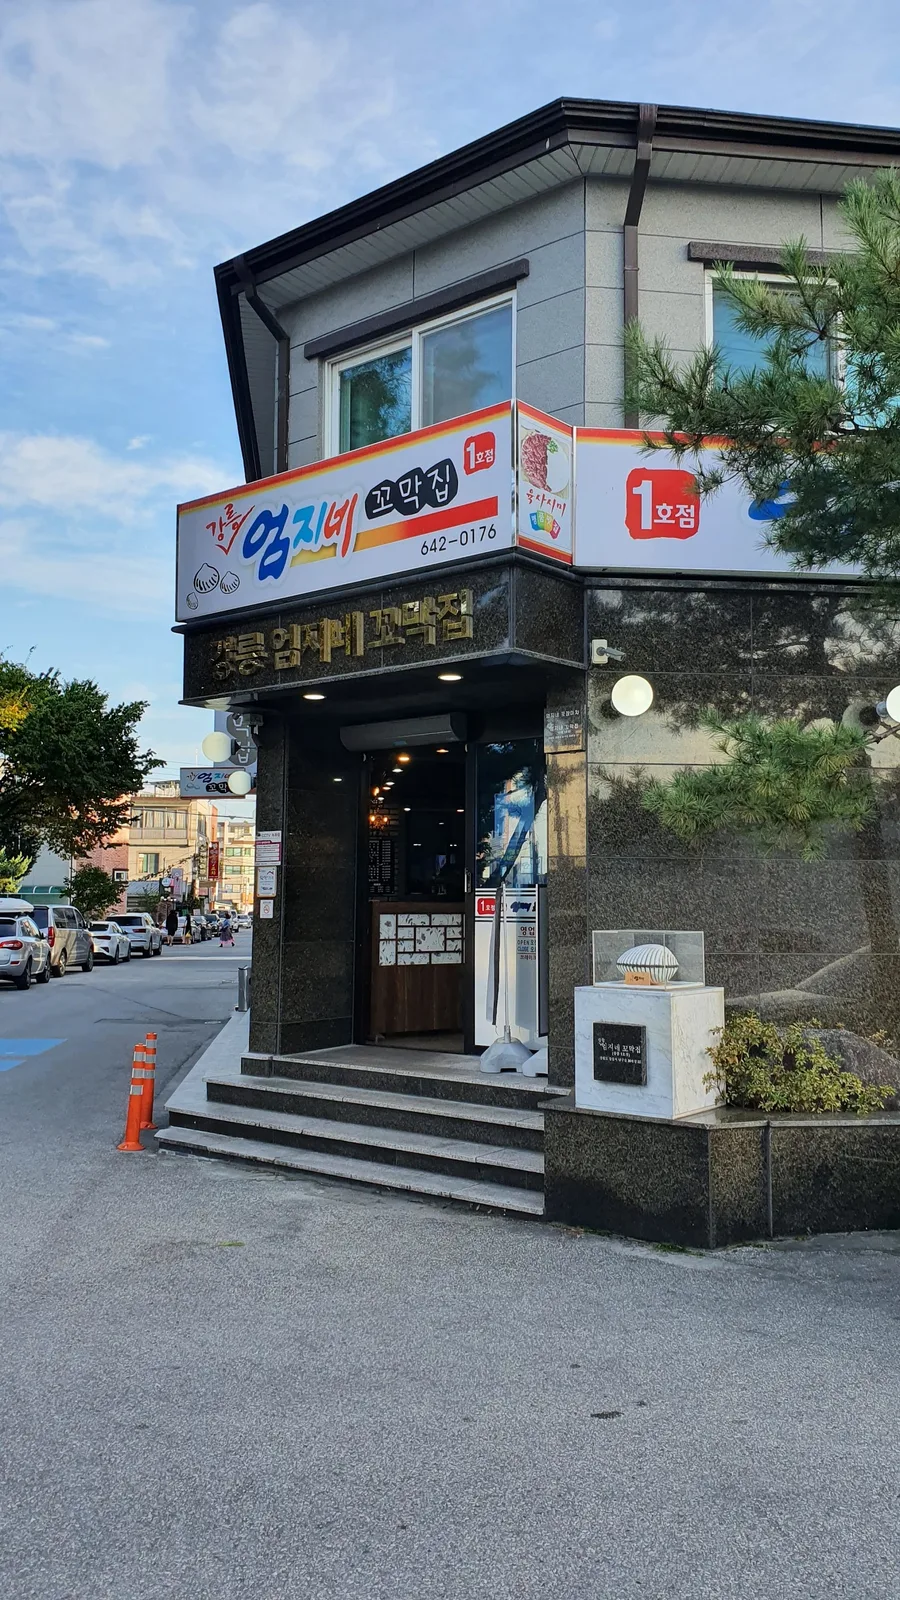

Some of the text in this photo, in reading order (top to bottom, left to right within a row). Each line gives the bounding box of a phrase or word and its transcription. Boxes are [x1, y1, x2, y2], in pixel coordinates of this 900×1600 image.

[466, 441, 495, 470] 1호점
[243, 493, 358, 581] 엄지네
[369, 466, 452, 515] 꼬막집
[526, 488, 567, 517] 육사시미
[632, 479, 696, 531] 1호점
[420, 523, 497, 557] 642-0176
[367, 588, 475, 649] 꼬막집
